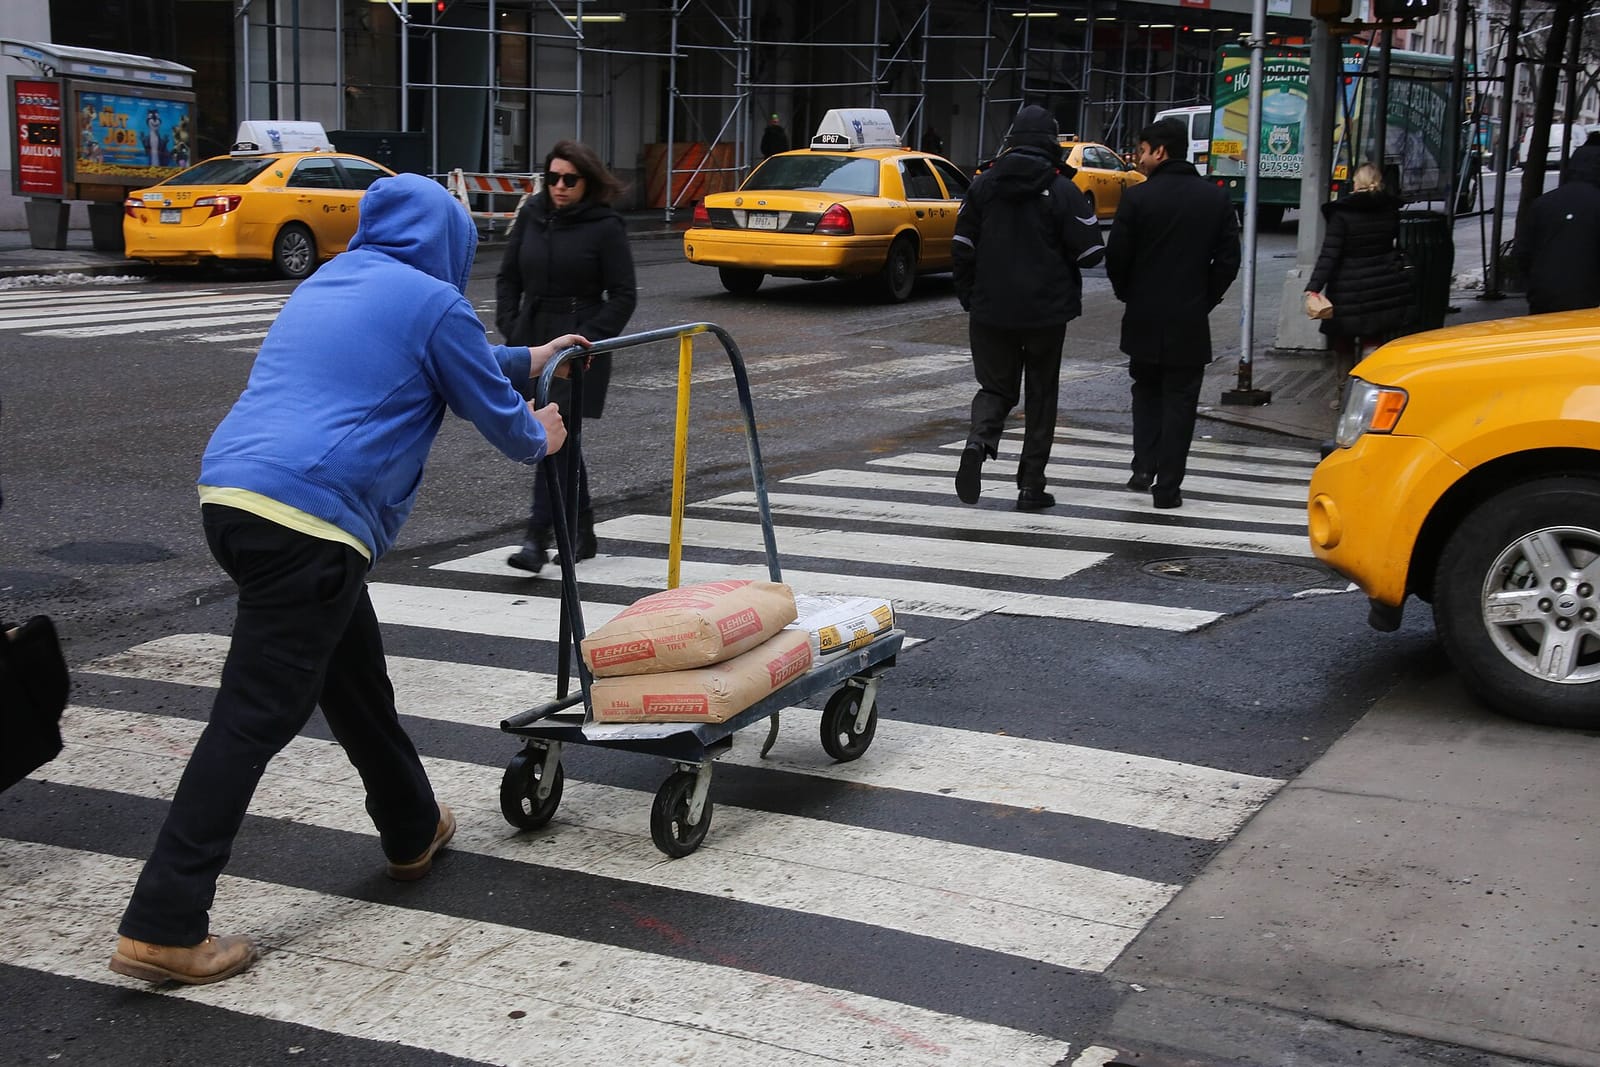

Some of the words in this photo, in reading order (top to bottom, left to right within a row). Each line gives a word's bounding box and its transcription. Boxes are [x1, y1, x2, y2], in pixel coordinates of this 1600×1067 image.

[104, 128, 137, 146] JOB
[822, 134, 839, 143] 8P67
[21, 145, 61, 157] MILLION
[721, 612, 755, 632] LEHIGH
[596, 642, 650, 659] LEHIGH
[775, 658, 810, 685] LEHIGH
[647, 704, 704, 714] LEHIGH
